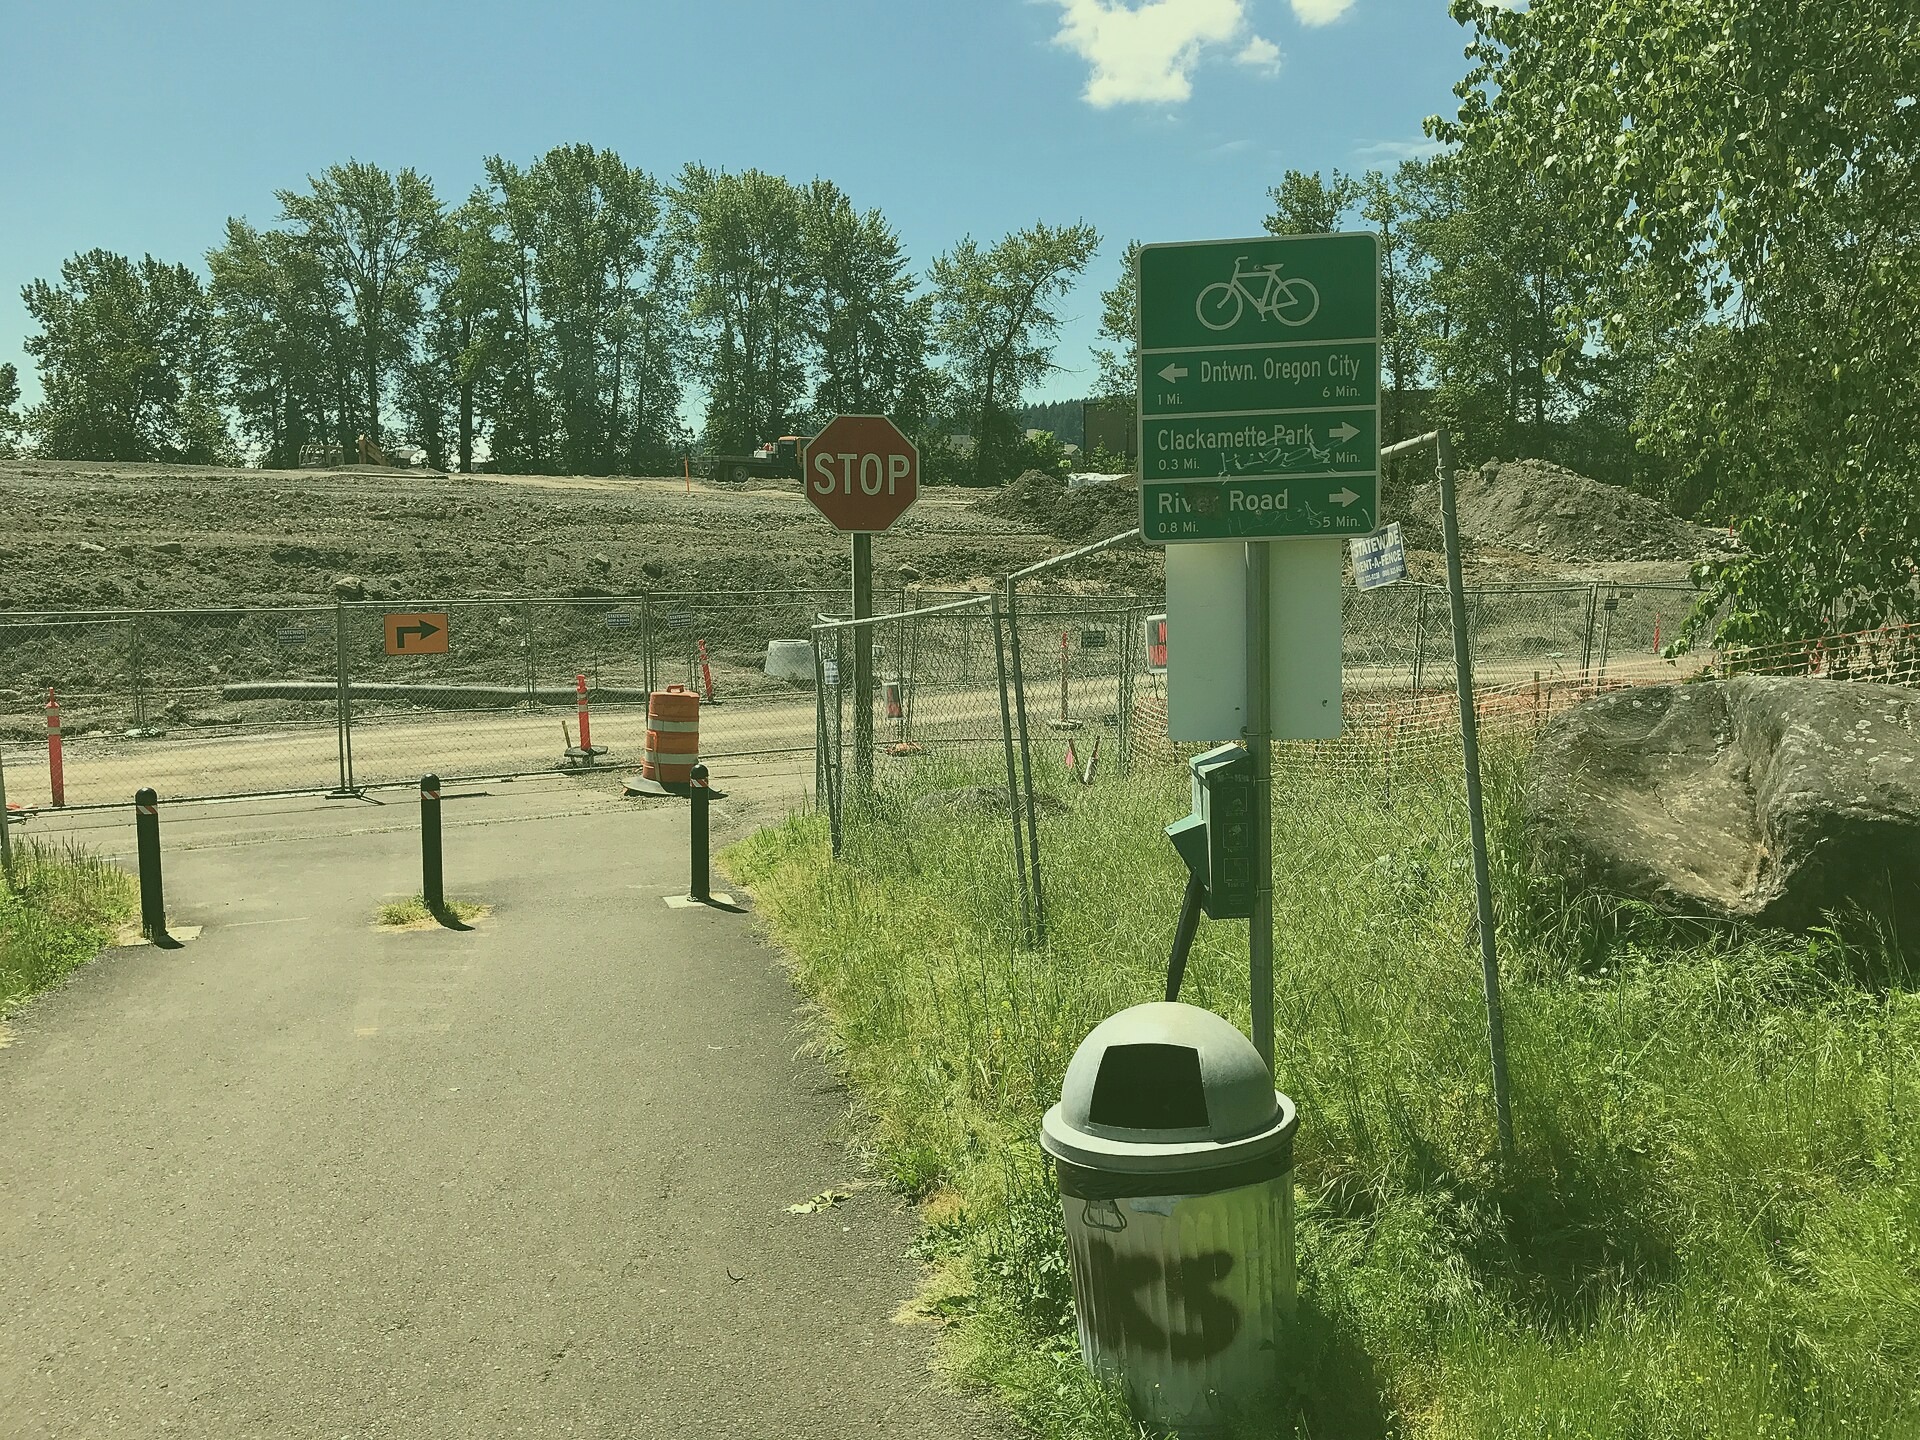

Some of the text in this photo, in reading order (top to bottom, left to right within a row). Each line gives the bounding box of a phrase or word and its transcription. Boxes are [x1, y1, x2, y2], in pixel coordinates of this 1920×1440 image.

[1201, 354, 1361, 385] Dntwn. Oregon City
[1157, 393, 1183, 405] 1 Mi.
[1322, 385, 1361, 398] 6 Min.
[1157, 423, 1315, 451] Clackamette Park
[1158, 458, 1200, 471] 0.3 Mi.
[1336, 451, 1361, 463] Min.
[813, 452, 911, 496] STOP
[1229, 488, 1288, 511] Road
[1158, 521, 1199, 534] 0.8 Mi.
[1322, 516, 1330, 528] 5
[1336, 515, 1361, 528] Min.
[1352, 529, 1400, 558] STATEWIDE
[1356, 549, 1402, 574] RENT-A-FENCE
